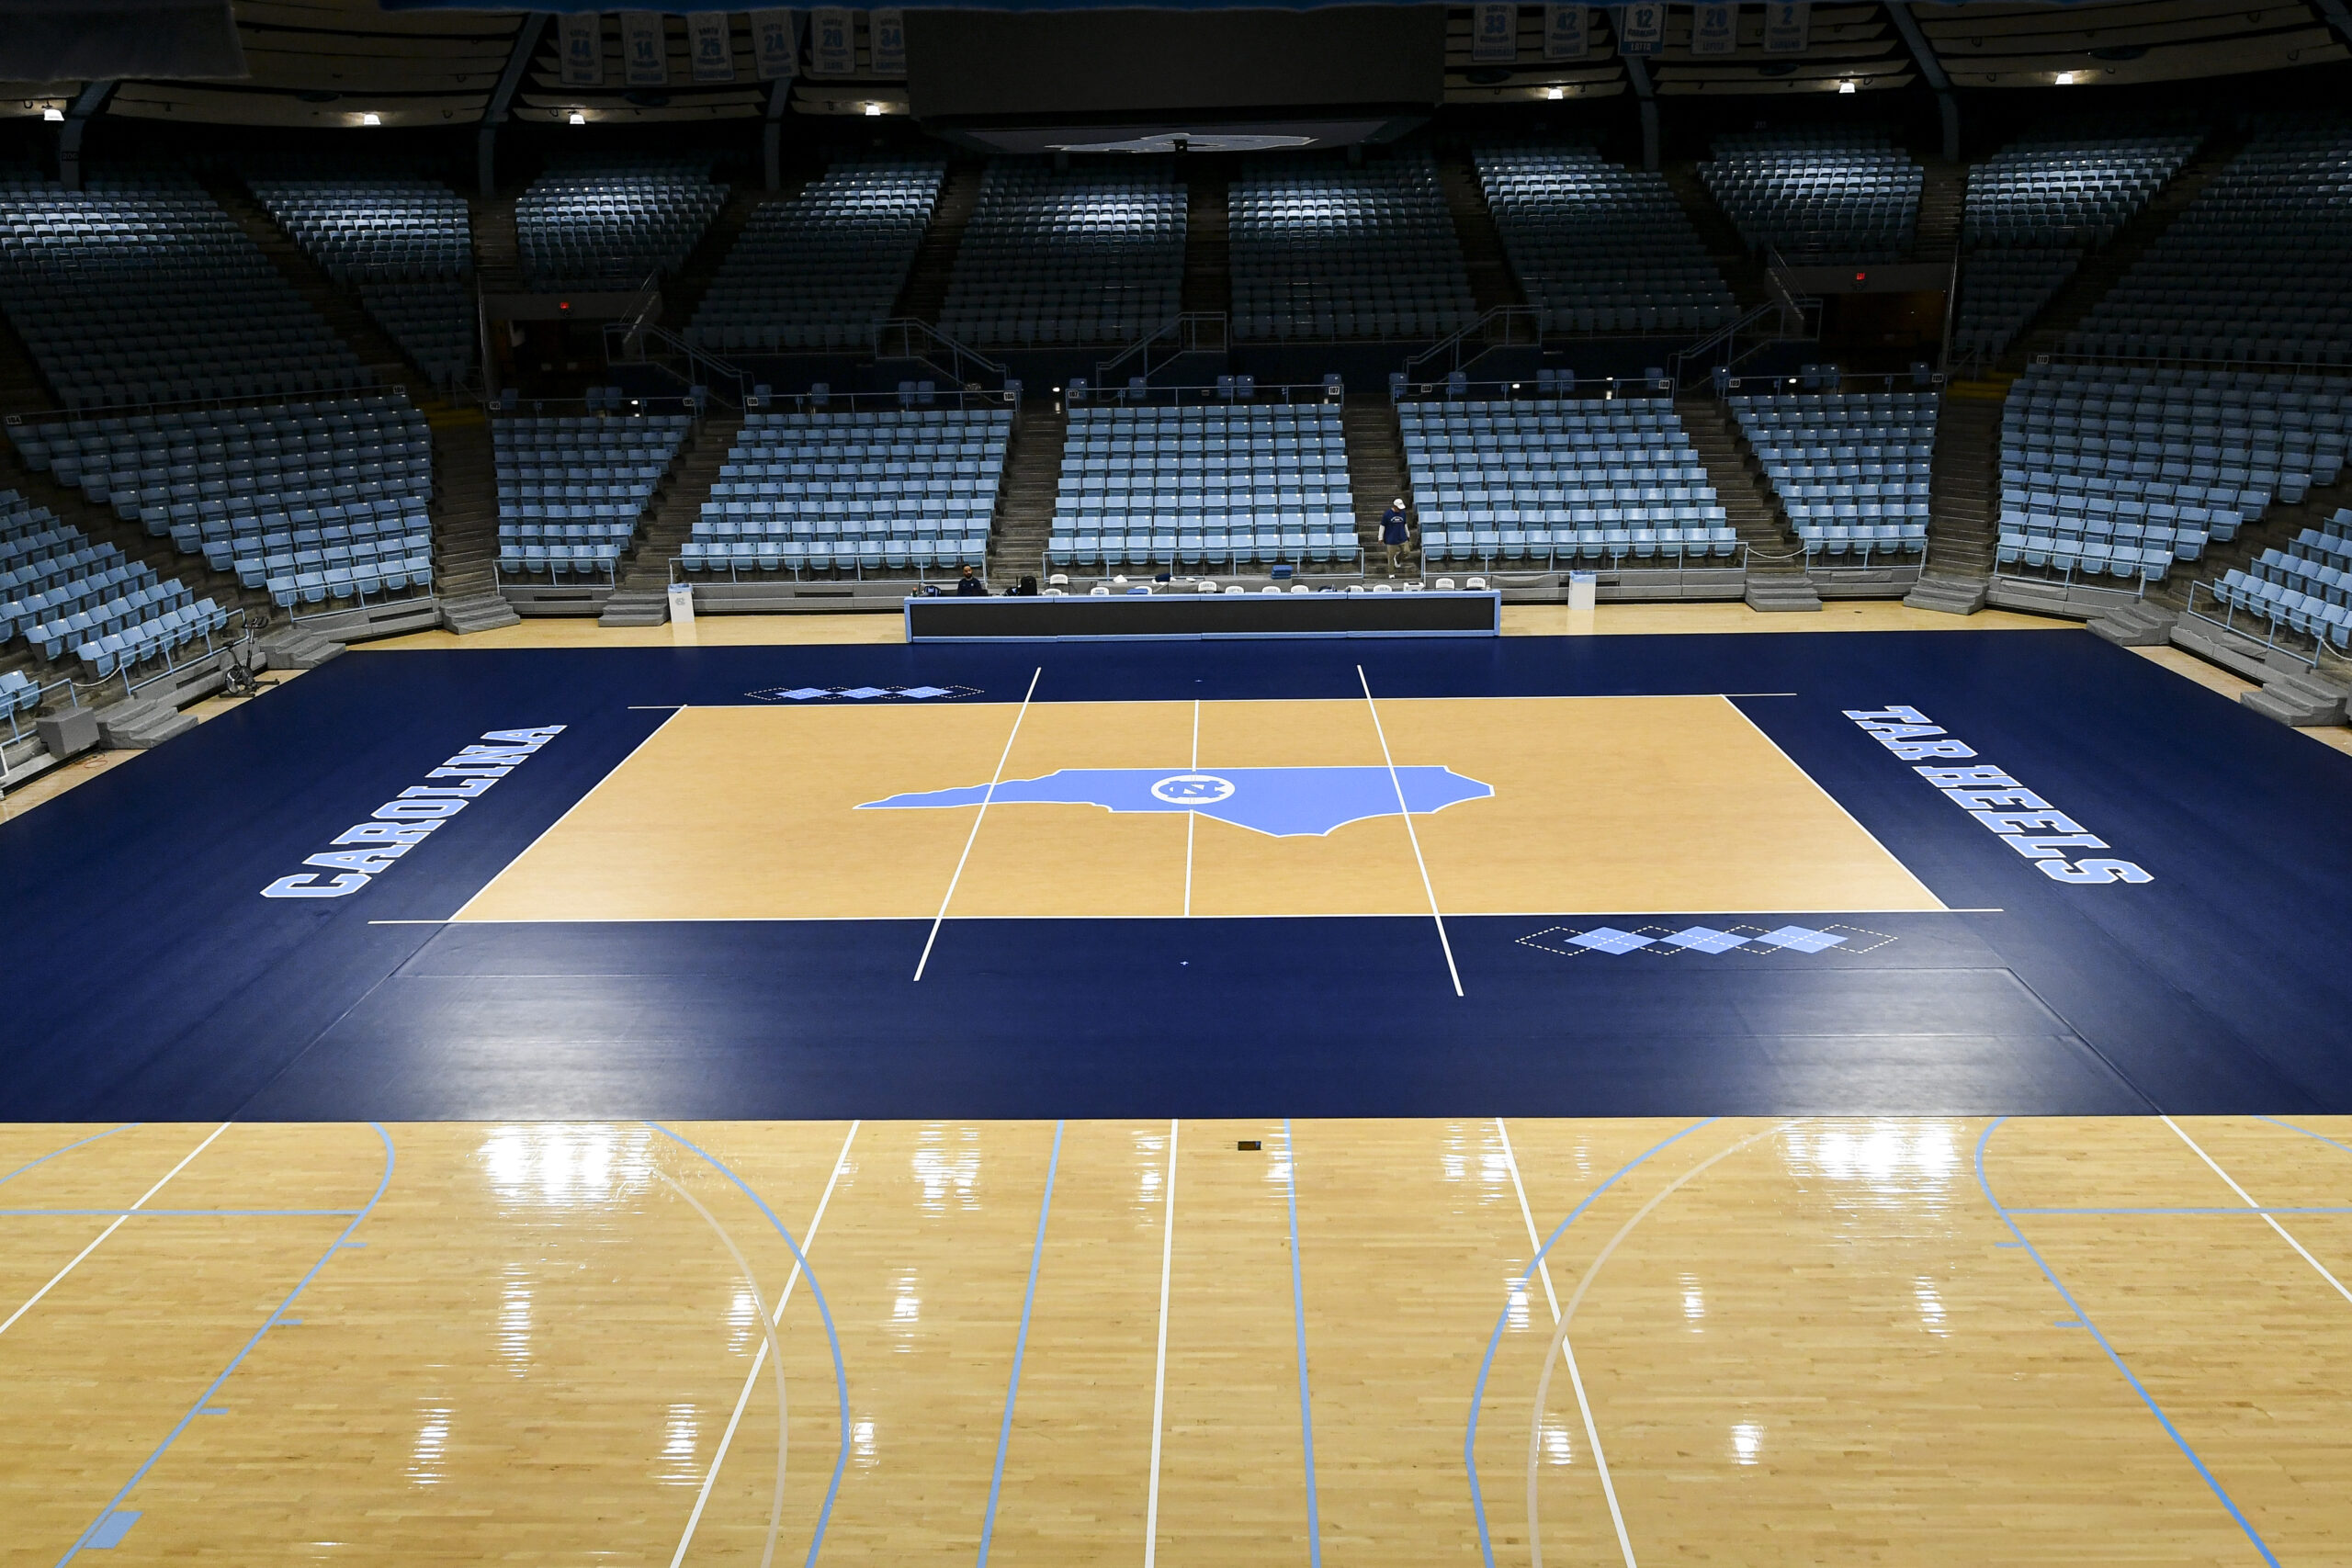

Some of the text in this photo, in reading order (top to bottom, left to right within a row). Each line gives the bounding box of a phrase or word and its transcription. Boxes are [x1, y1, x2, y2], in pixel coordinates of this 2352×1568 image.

[1485, 15, 1506, 34] 33
[1556, 12, 1577, 30] 42
[1635, 8, 1654, 28] 12
[1706, 8, 1727, 28] 20
[1782, 6, 1793, 25] 2
[700, 38, 721, 56] 25
[764, 33, 786, 52] 24
[881, 28, 901, 47] 34
[571, 39, 592, 57] 44
[1841, 705, 2154, 884] TAR HEELS
[260, 725, 568, 897] CAROLINA
